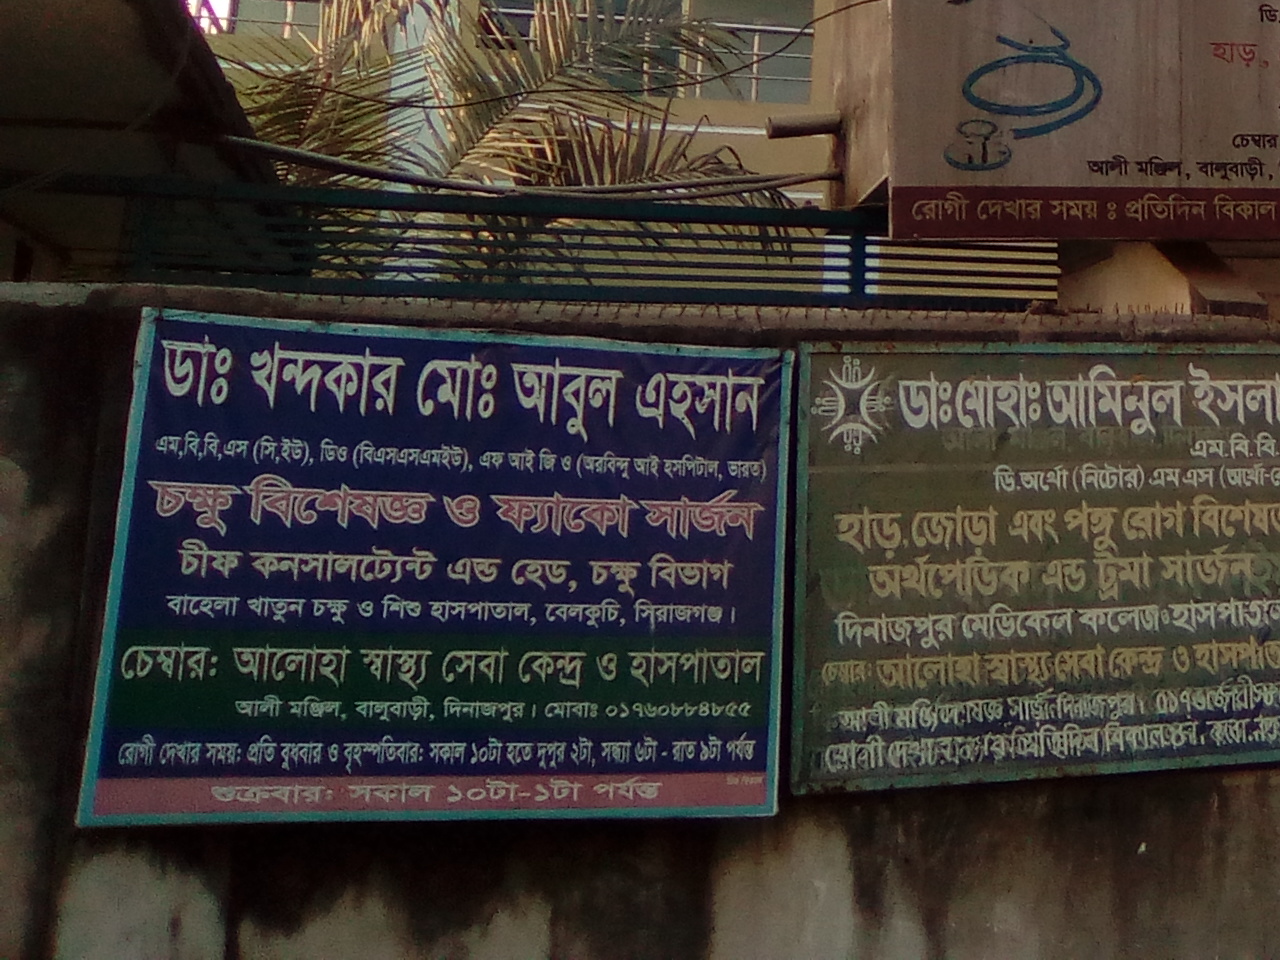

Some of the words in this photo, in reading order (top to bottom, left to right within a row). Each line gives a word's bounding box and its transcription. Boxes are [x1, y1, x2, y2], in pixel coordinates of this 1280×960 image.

[1087, 154, 1129, 176] আলী
[912, 191, 969, 221] রোগী
[977, 198, 1043, 221] দেখার
[1050, 199, 1098, 221] সময়
[1125, 193, 1206, 221] প্রতিদিন
[1213, 194, 1277, 221] বিকাল
[161, 334, 233, 407] ডাঃ
[250, 341, 405, 417] খন্দকার
[417, 354, 497, 421] মোঃ
[510, 357, 624, 443] আবুল
[636, 368, 765, 440] এহসান
[1046, 364, 1188, 436] আমিনুল
[320, 438, 348, 462] ডিও
[479, 451, 505, 470] এফ
[508, 449, 535, 473] আই
[539, 448, 557, 472] জি
[561, 454, 572, 471] ও
[633, 453, 659, 477] আই
[147, 480, 241, 537] চক্ষু
[243, 473, 436, 529] বিশেষজ্ঞ
[443, 495, 480, 527] ও
[490, 491, 640, 539] ফ্যাকো
[639, 489, 766, 540] সার্জন
[911, 504, 999, 557] জোড়া
[1008, 509, 1060, 544] এবং
[1064, 499, 1120, 556] পঙ্গু
[1122, 500, 1187, 540] রোগ
[178, 538, 243, 579] চীফ
[447, 557, 502, 585] এন্ড
[511, 559, 577, 592] হেড,
[589, 560, 642, 597] চক্ষু
[647, 552, 734, 590] বিভাগ
[1042, 559, 1087, 593] এন্ড
[1093, 550, 1152, 601] ট্রমা
[166, 593, 240, 620] বাহেলা
[247, 596, 305, 623] খাতুন
[311, 599, 349, 624] চক্ষু
[357, 600, 373, 616] ও
[381, 594, 422, 619] শিশু
[429, 600, 537, 626] হাসপাতাল,
[834, 611, 956, 650] দিনাজপুর
[961, 603, 1075, 640] মেডিকেল
[1079, 604, 1160, 635] কলেজ
[232, 644, 351, 688] আলোহা
[360, 645, 432, 691] স্বাস্থ্য
[442, 646, 509, 684] সেবা
[519, 647, 587, 689] কেন্দ্র
[597, 652, 618, 682] ও
[628, 647, 765, 687] হাসপাতাল
[876, 651, 980, 689] আলোহা
[1055, 643, 1107, 680] সেবা
[1108, 645, 1166, 677] কেন্দ্র
[1172, 646, 1192, 673] ও
[235, 694, 283, 718] আলী
[605, 701, 752, 719] ০১৭৬০৮৮৪৮৫৫
[118, 734, 156, 765] রোগী
[160, 742, 202, 765] দেখার
[247, 734, 278, 765] প্রতি
[280, 741, 323, 771] বুধবার
[327, 744, 338, 763] ও
[430, 741, 466, 764] সকাল
[470, 737, 503, 765] ১০টা
[506, 741, 534, 766] হতে
[537, 741, 566, 770] দুপুর
[634, 735, 658, 762] ৬টা
[672, 740, 696, 762] রাত
[699, 736, 721, 763] ৯টা
[725, 732, 756, 761] পর্যন্ত
[348, 782, 435, 804] সকাল
[593, 776, 663, 801] পর্যন্ত
